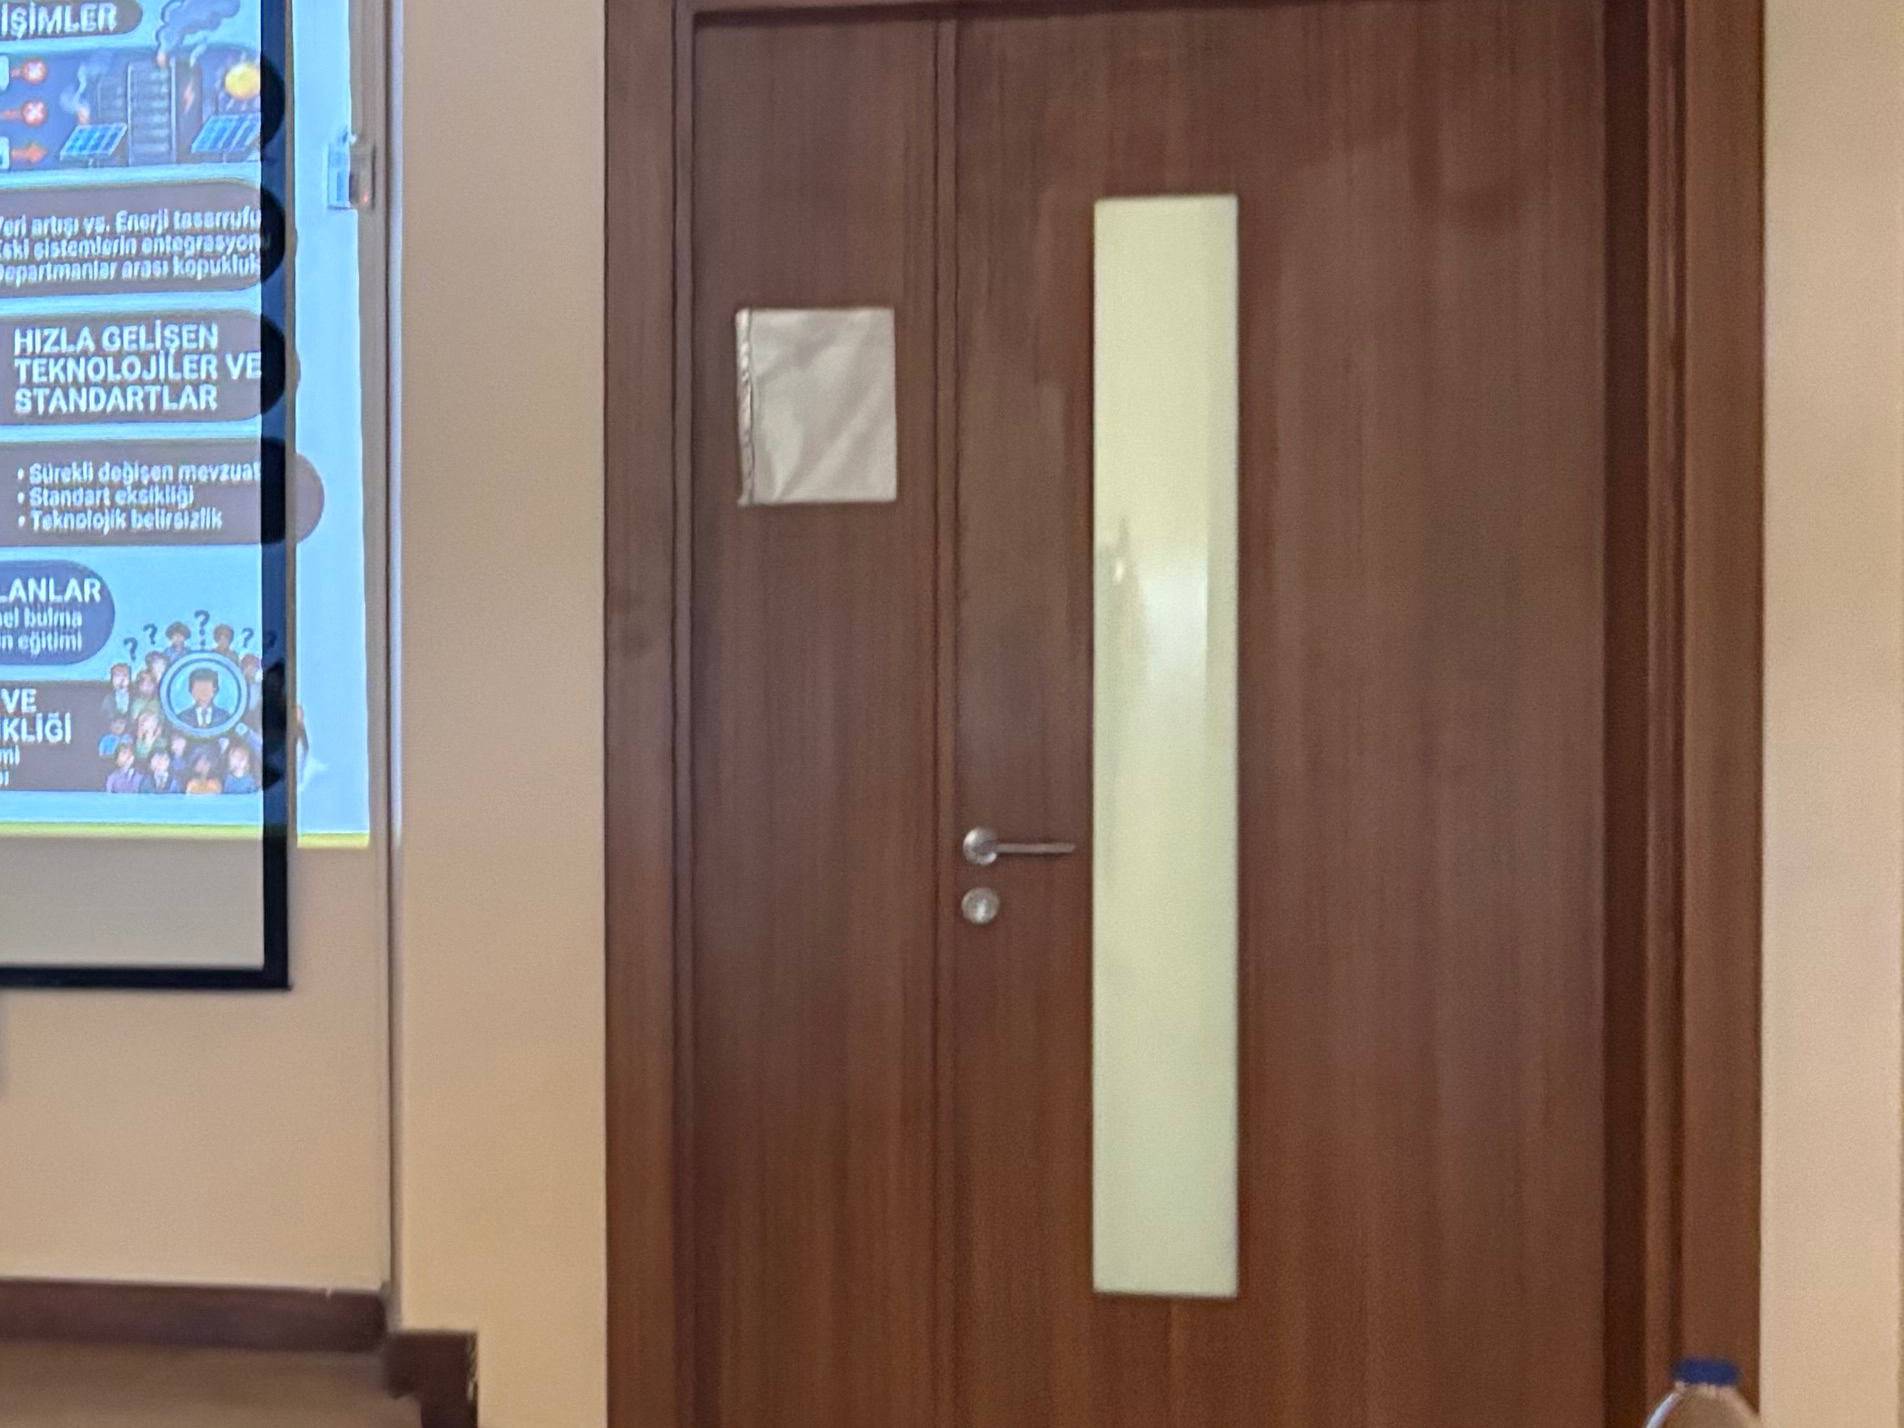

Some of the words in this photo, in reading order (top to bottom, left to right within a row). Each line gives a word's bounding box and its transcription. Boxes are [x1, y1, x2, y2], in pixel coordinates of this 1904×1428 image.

[116, 208, 168, 234] Enerji
[34, 236, 137, 258] sistemlerin
[14, 326, 95, 355] HIZLA
[102, 320, 218, 354] GELİŞEN
[14, 350, 217, 384] TEKNOLOJİLER
[226, 352, 261, 379] VE
[14, 383, 218, 415] STANDARTLAR
[29, 461, 93, 484] Sürekli
[29, 485, 110, 506] Standart
[30, 508, 126, 535] Teknolojik
[0, 688, 37, 712] VE
